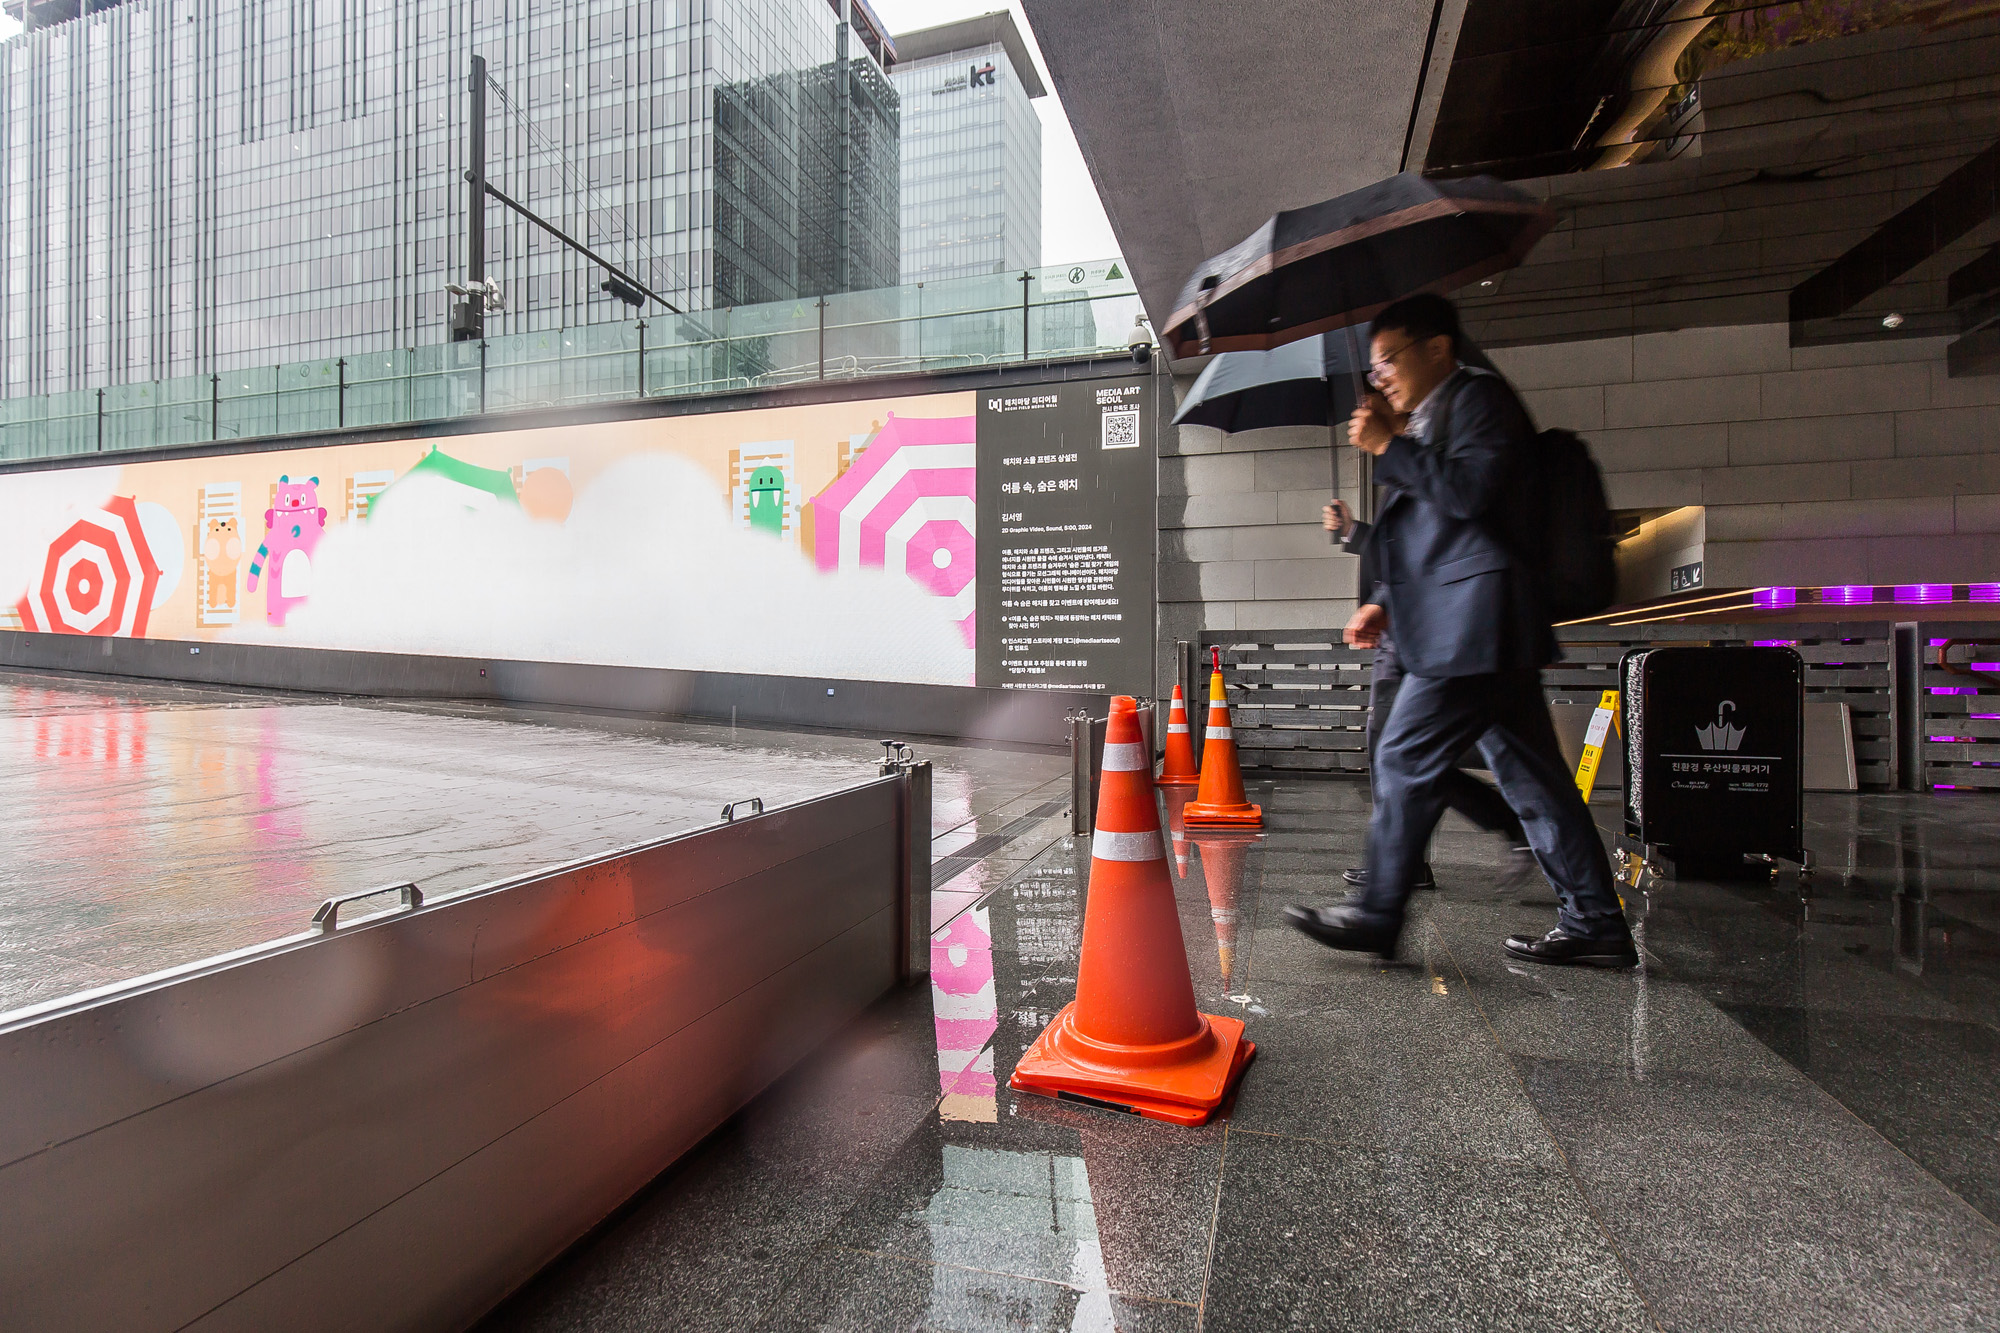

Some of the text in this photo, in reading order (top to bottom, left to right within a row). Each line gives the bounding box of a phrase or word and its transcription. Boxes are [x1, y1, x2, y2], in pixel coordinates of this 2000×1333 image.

[970, 62, 996, 88] kt
[1096, 386, 1141, 397] MEDIA ART
[1005, 395, 1058, 406] 해치마당 미디어월
[1096, 396, 1122, 404] SEOUL
[1003, 453, 1077, 466] 해치와 소울 프렌즈 상설전
[1002, 478, 1078, 494] 여름 속, 숨은 해치
[1002, 512, 1022, 522] 김서영
[1672, 762, 1770, 774] 친환경 우산빗물제거기
